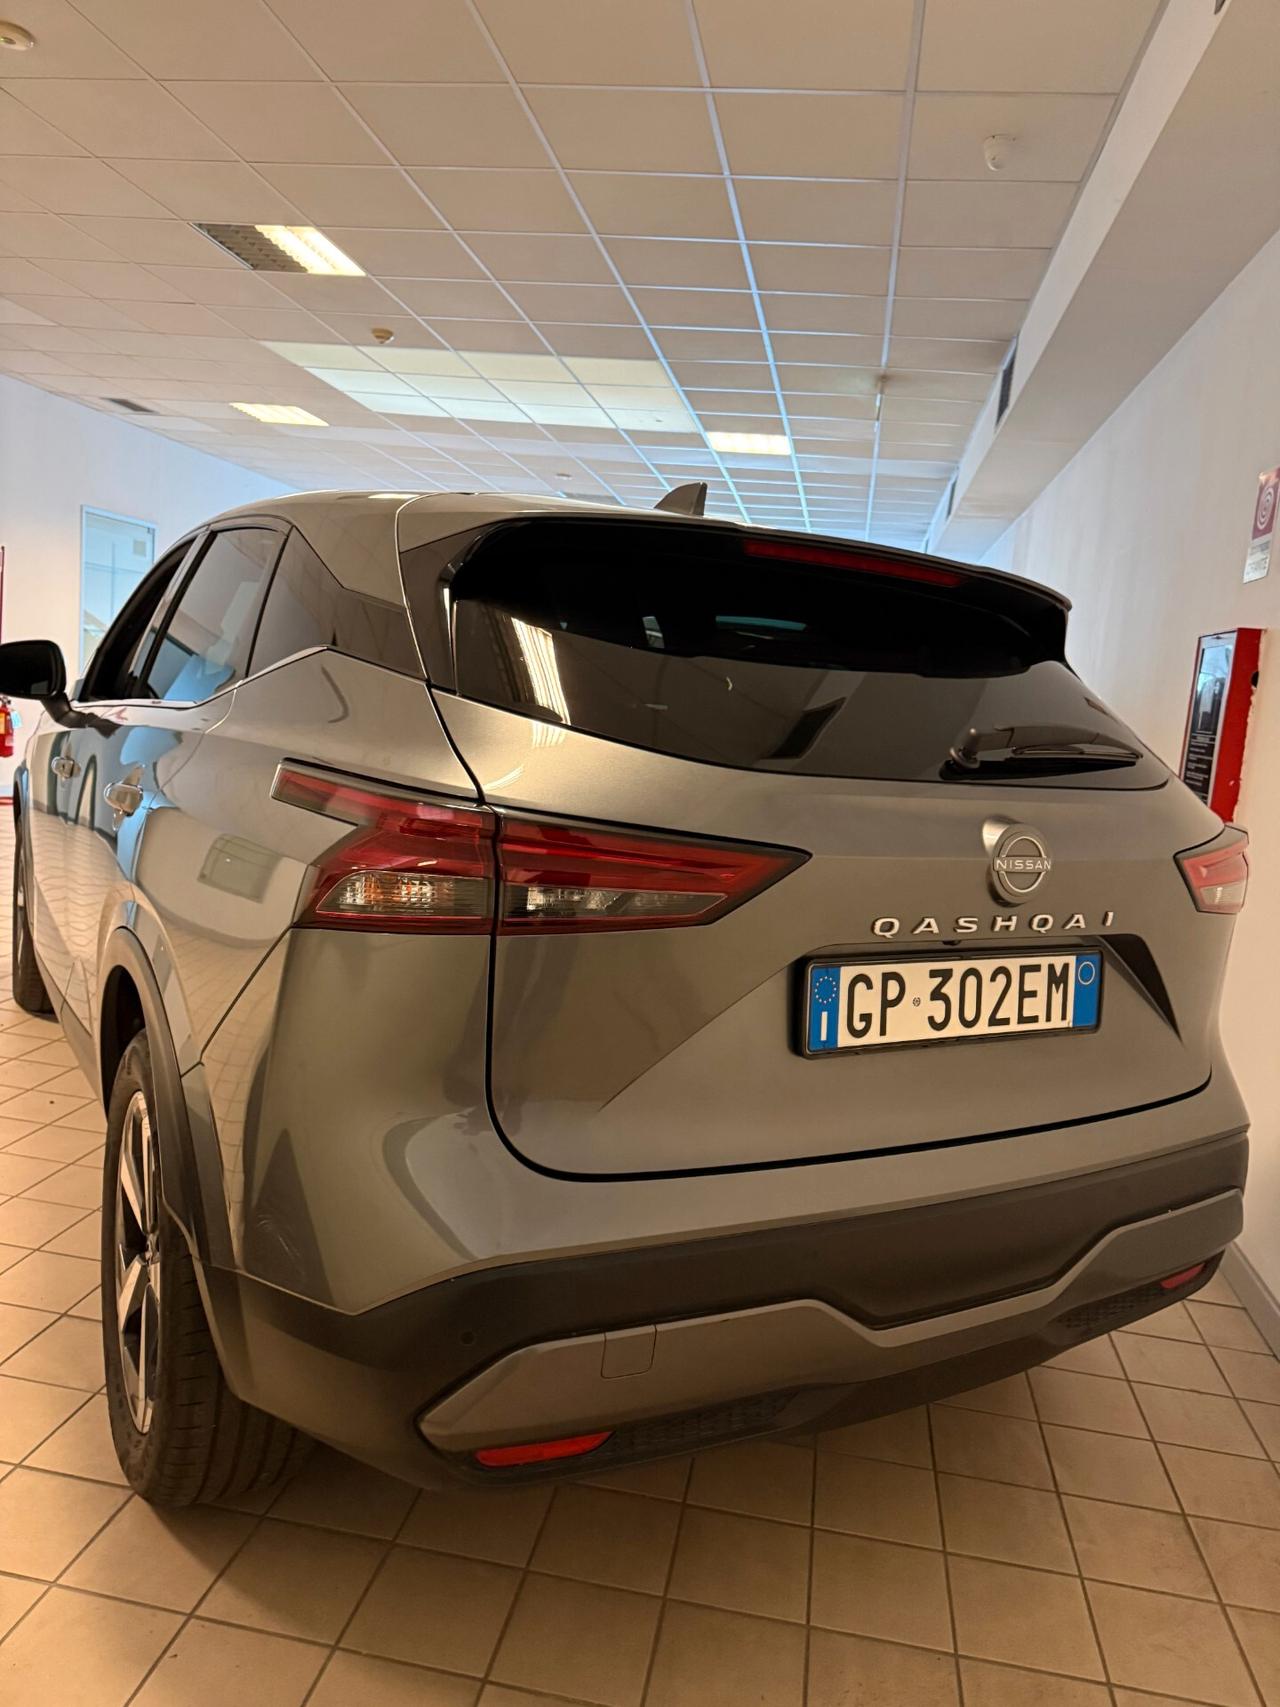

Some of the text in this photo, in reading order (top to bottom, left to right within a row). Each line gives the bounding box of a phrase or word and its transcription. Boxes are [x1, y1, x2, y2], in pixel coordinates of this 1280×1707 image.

[996, 859, 1051, 870] NISSAN
[873, 911, 1115, 938] QASHQAI
[846, 962, 1070, 1038] GP 302EM
[820, 1011, 828, 1041] I
